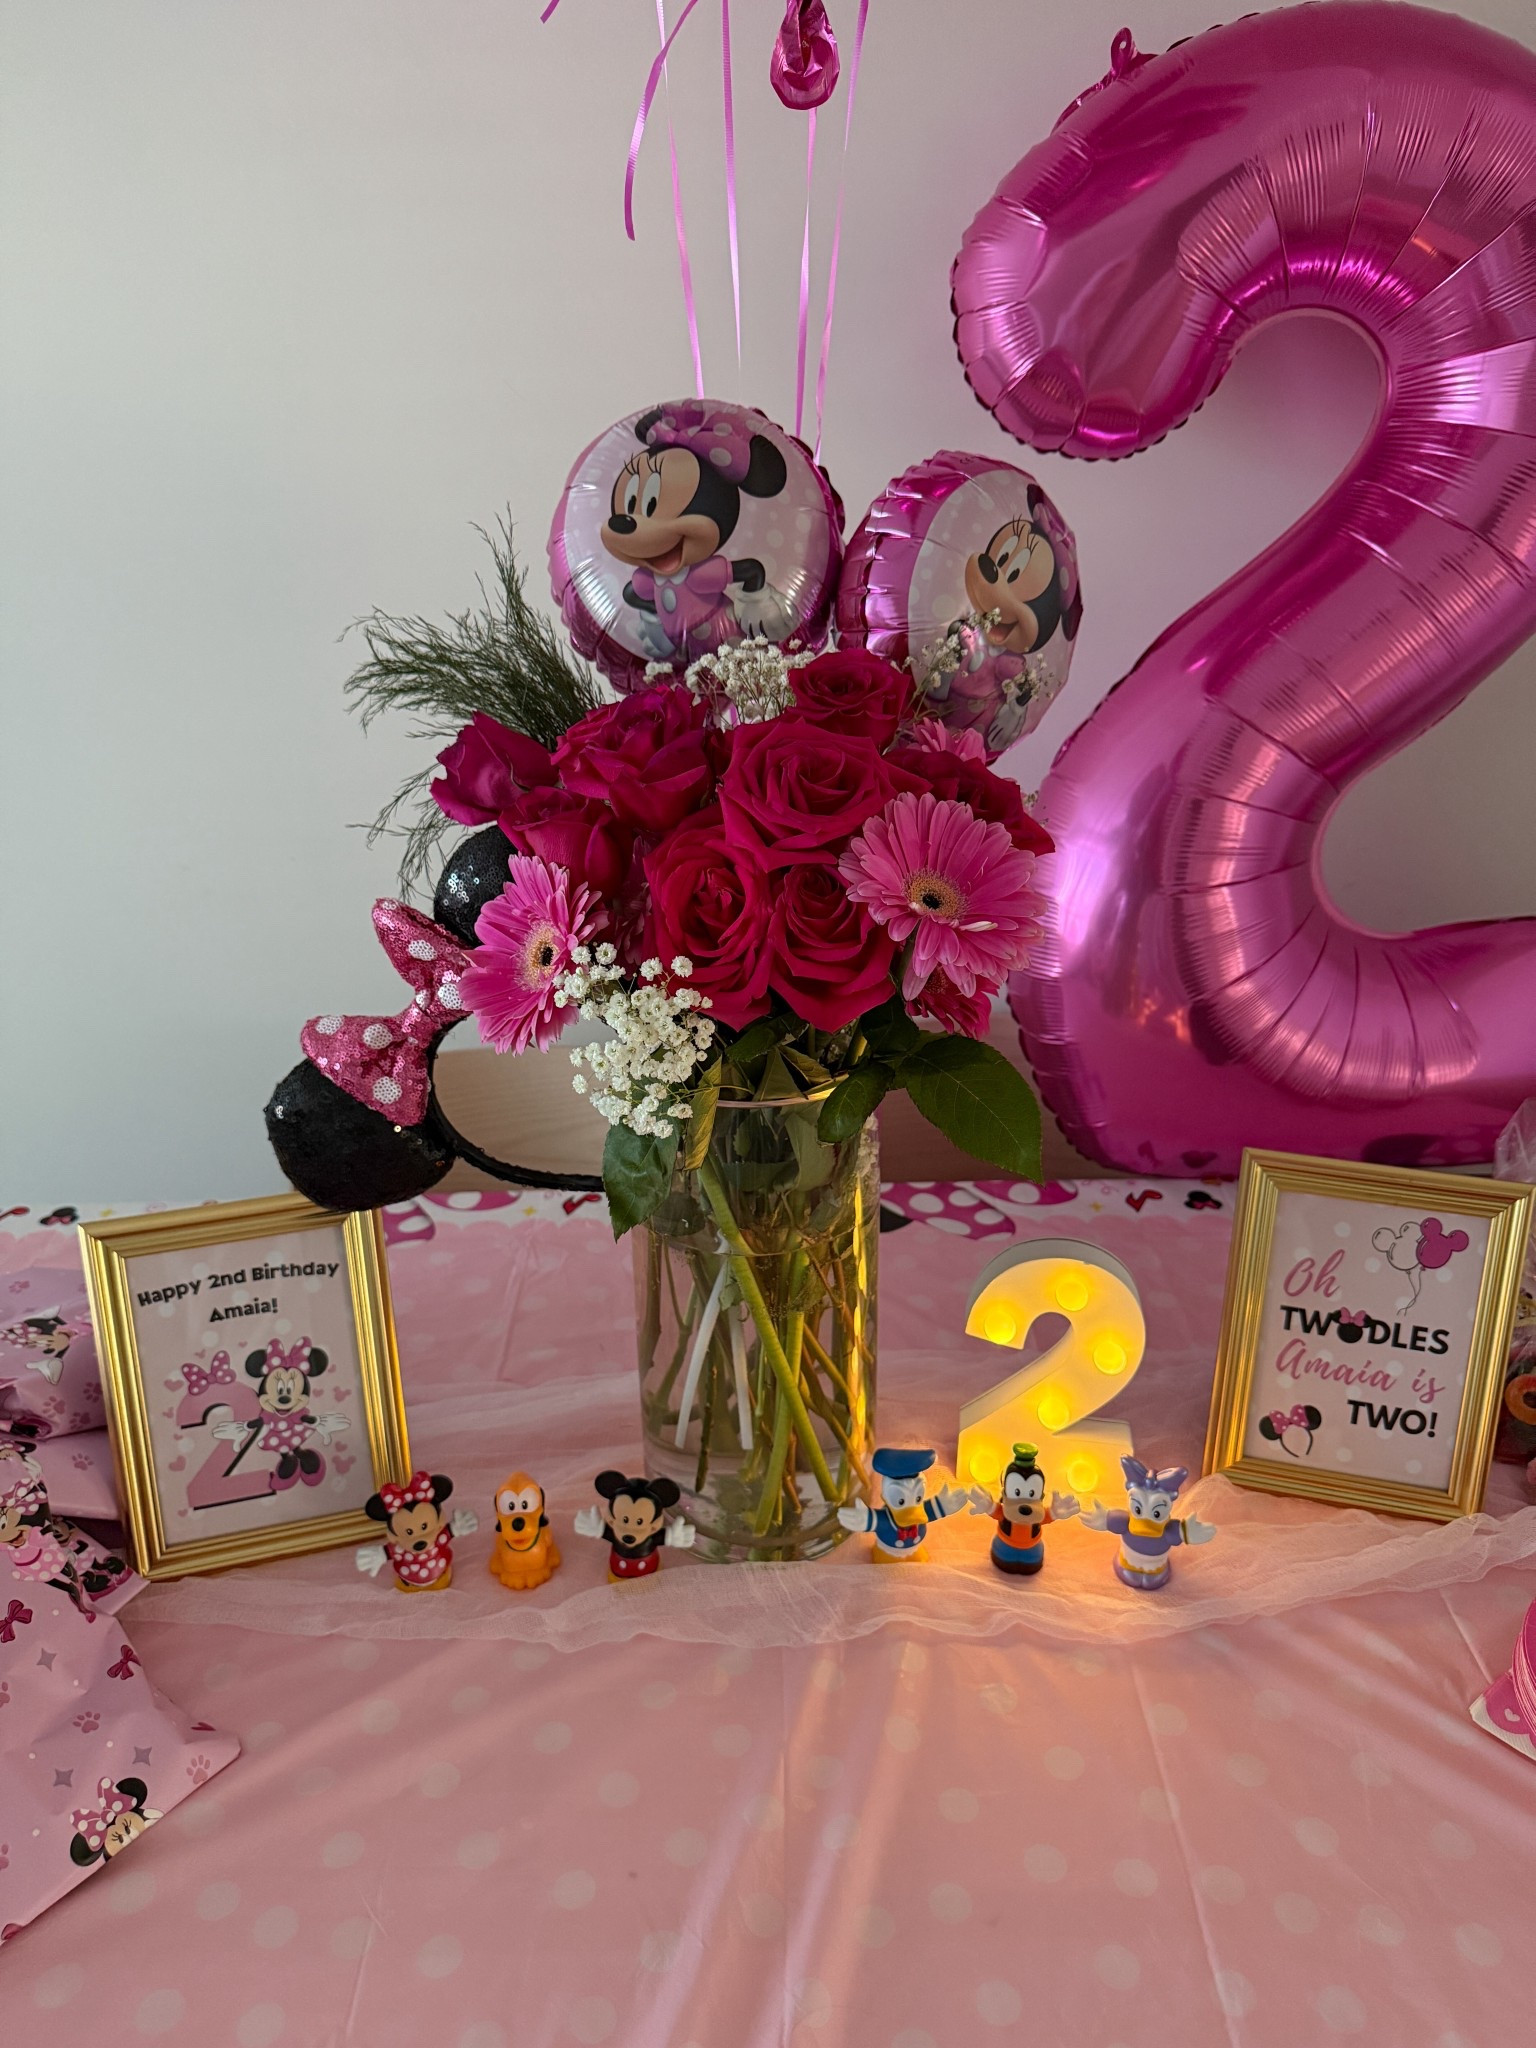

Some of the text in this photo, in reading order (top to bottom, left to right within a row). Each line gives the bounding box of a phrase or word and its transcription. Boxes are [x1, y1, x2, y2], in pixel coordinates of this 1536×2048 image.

[952, 0, 1536, 1176] 2
[137, 1261, 340, 1306] Happy 2nd Birthday
[1284, 1249, 1345, 1298] Oh
[209, 1299, 279, 1322] Amaia!
[956, 1238, 1146, 1510] 2
[1275, 1338, 1446, 1404] Amaia is
[176, 1379, 277, 1510] 2
[1347, 1399, 1439, 1438] TWO!
